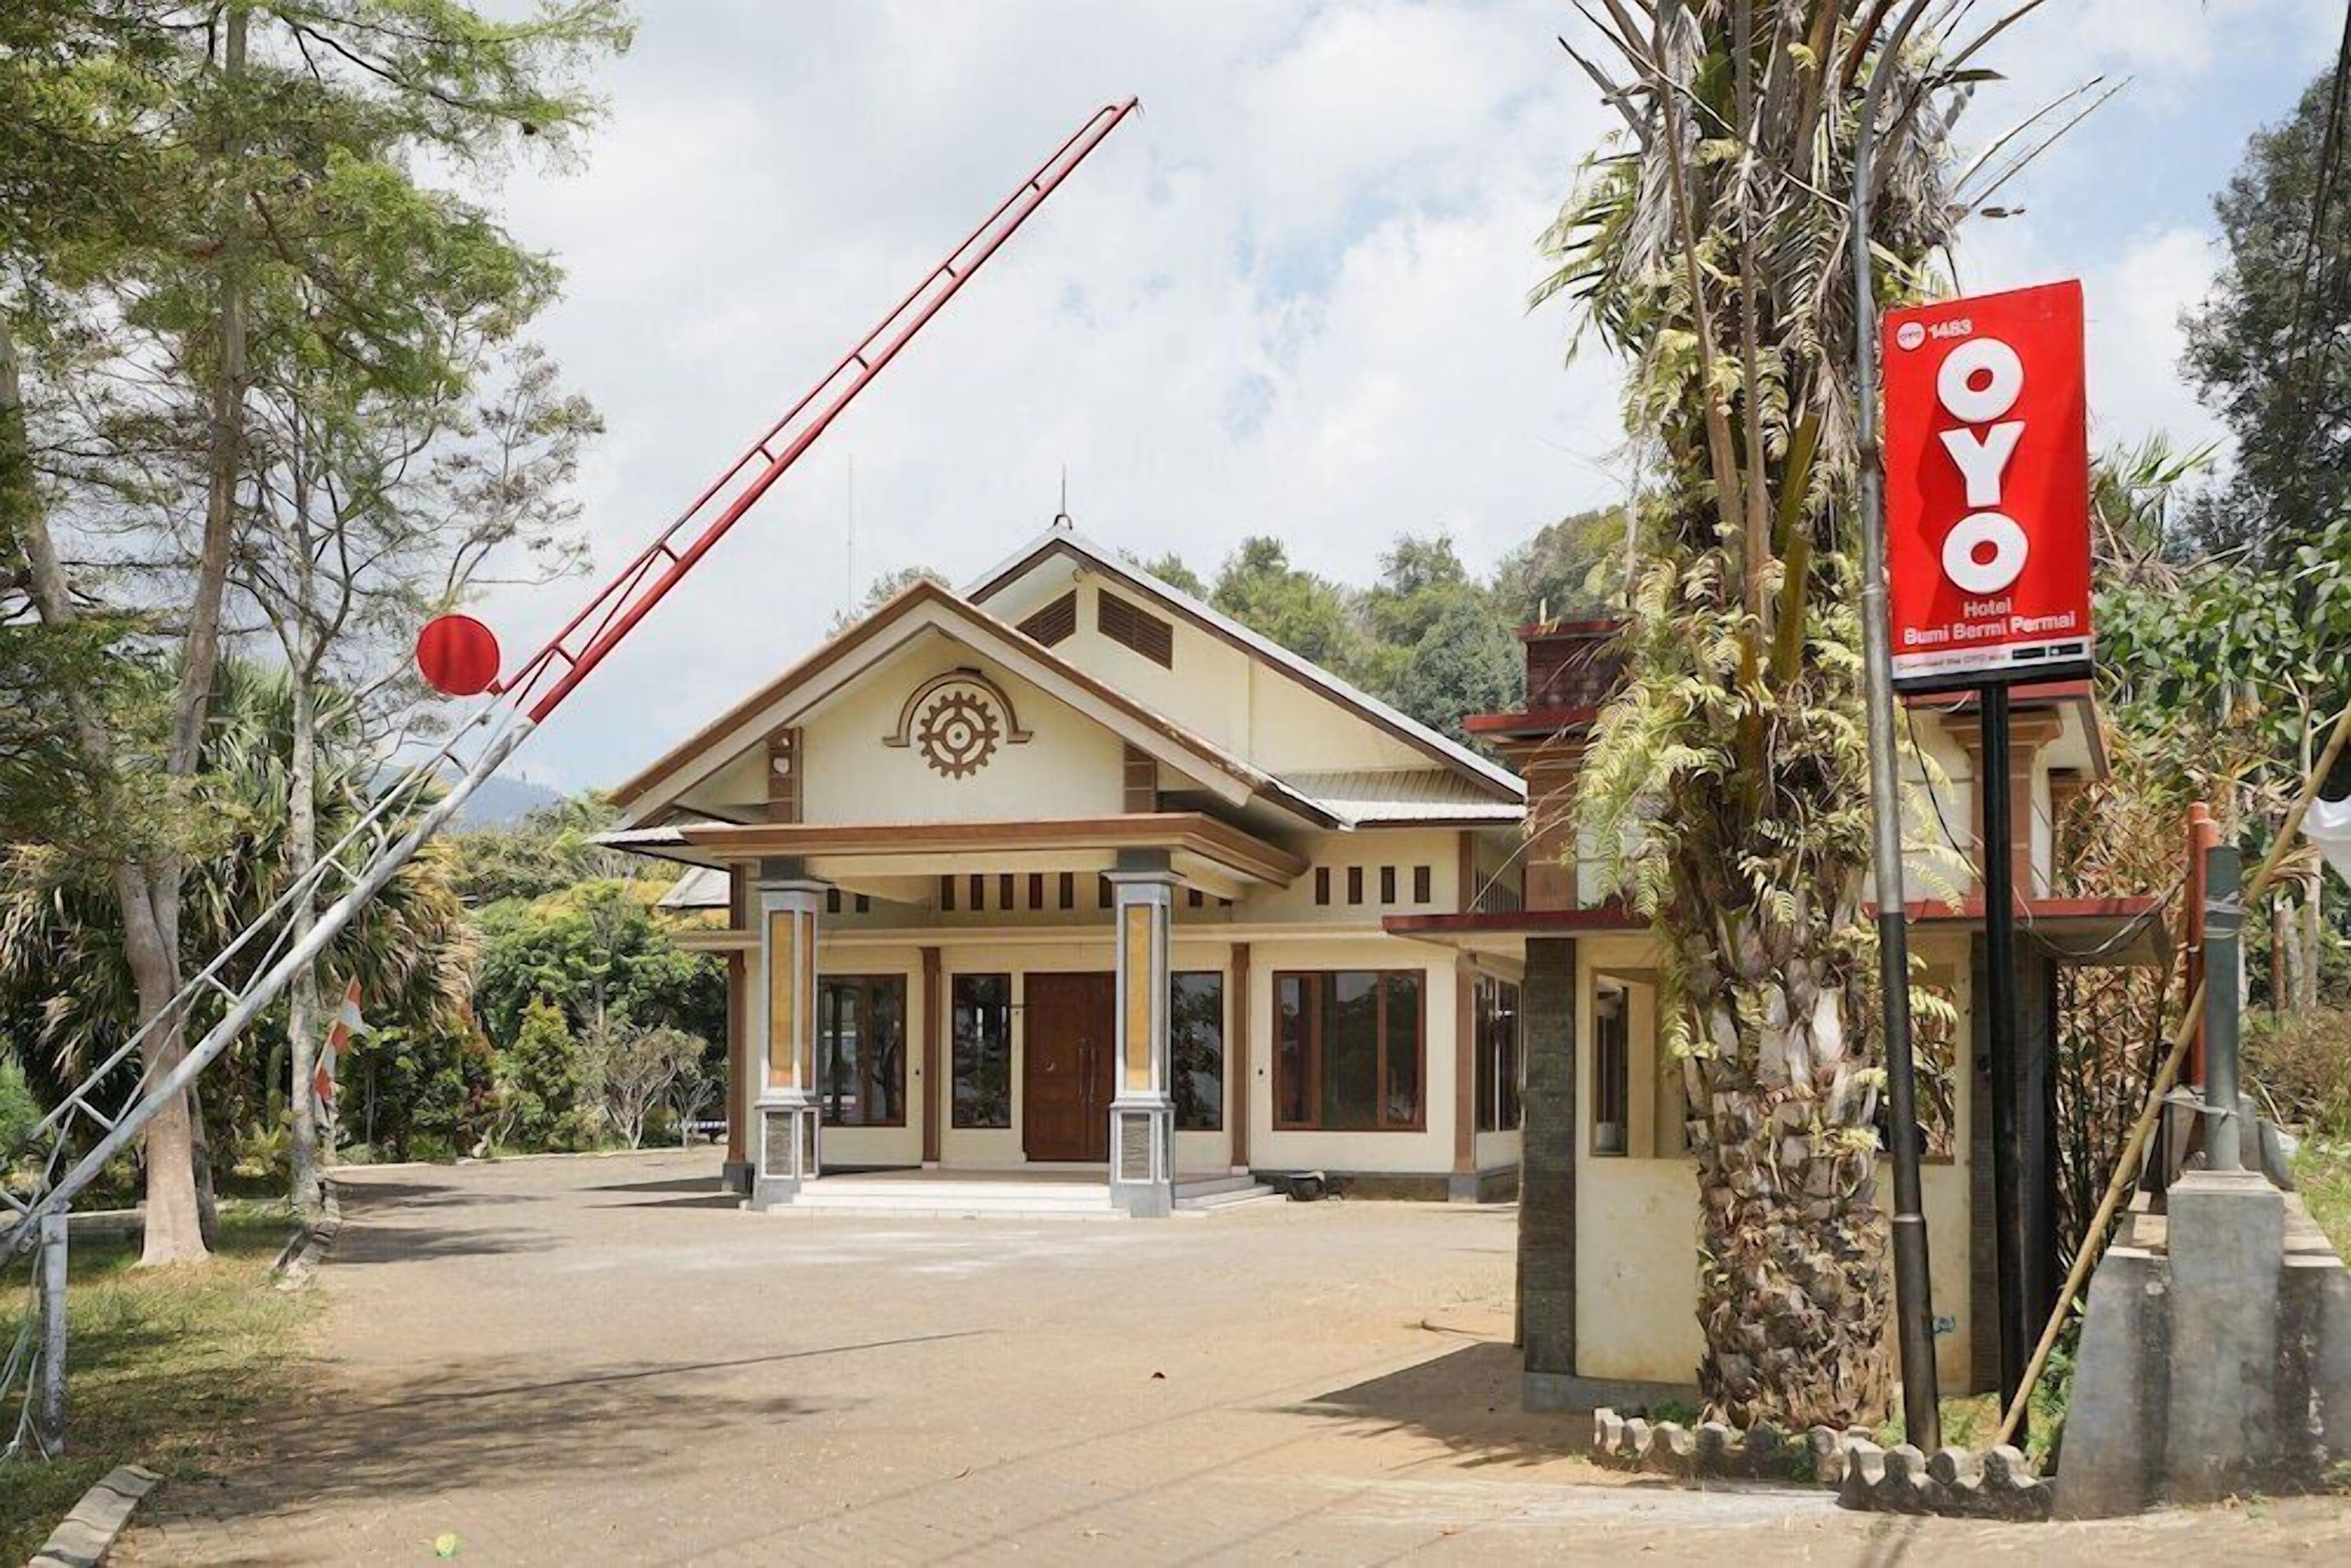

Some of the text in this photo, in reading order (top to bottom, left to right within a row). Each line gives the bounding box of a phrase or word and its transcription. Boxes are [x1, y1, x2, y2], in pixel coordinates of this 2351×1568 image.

[1937, 337, 2030, 594] OYO
[1964, 597, 2011, 617] Hotel
[1904, 625, 1950, 645] Bumi
[2010, 611, 2076, 634] Permai
